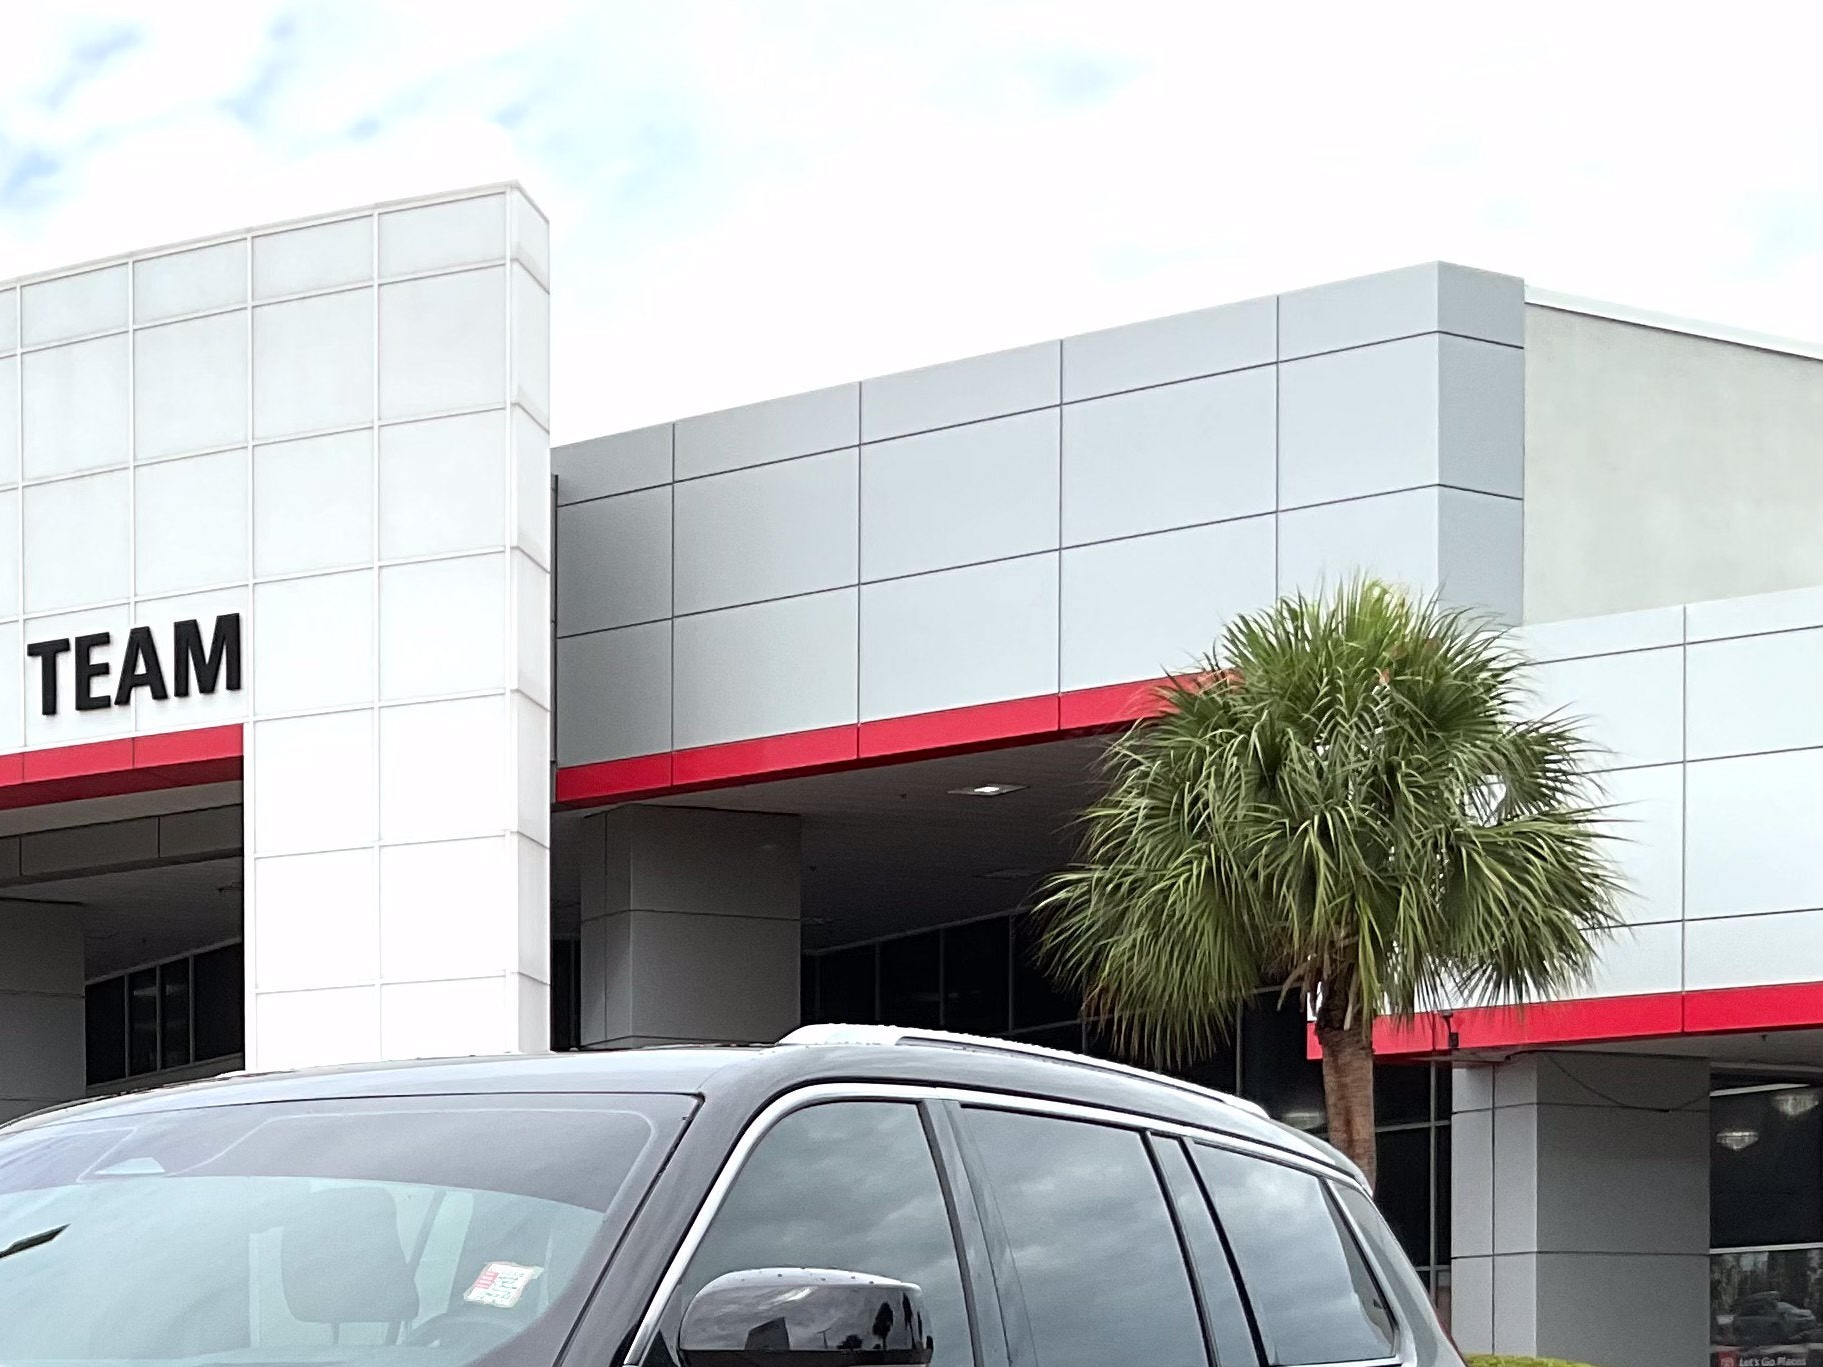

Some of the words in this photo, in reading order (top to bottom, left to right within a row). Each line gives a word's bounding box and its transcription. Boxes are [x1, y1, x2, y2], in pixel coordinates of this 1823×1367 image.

[26, 612, 242, 717] TEAM
[1739, 1356, 1760, 1367] Let's
[1761, 1356, 1776, 1367] Go
[1777, 1356, 1807, 1367] Places
